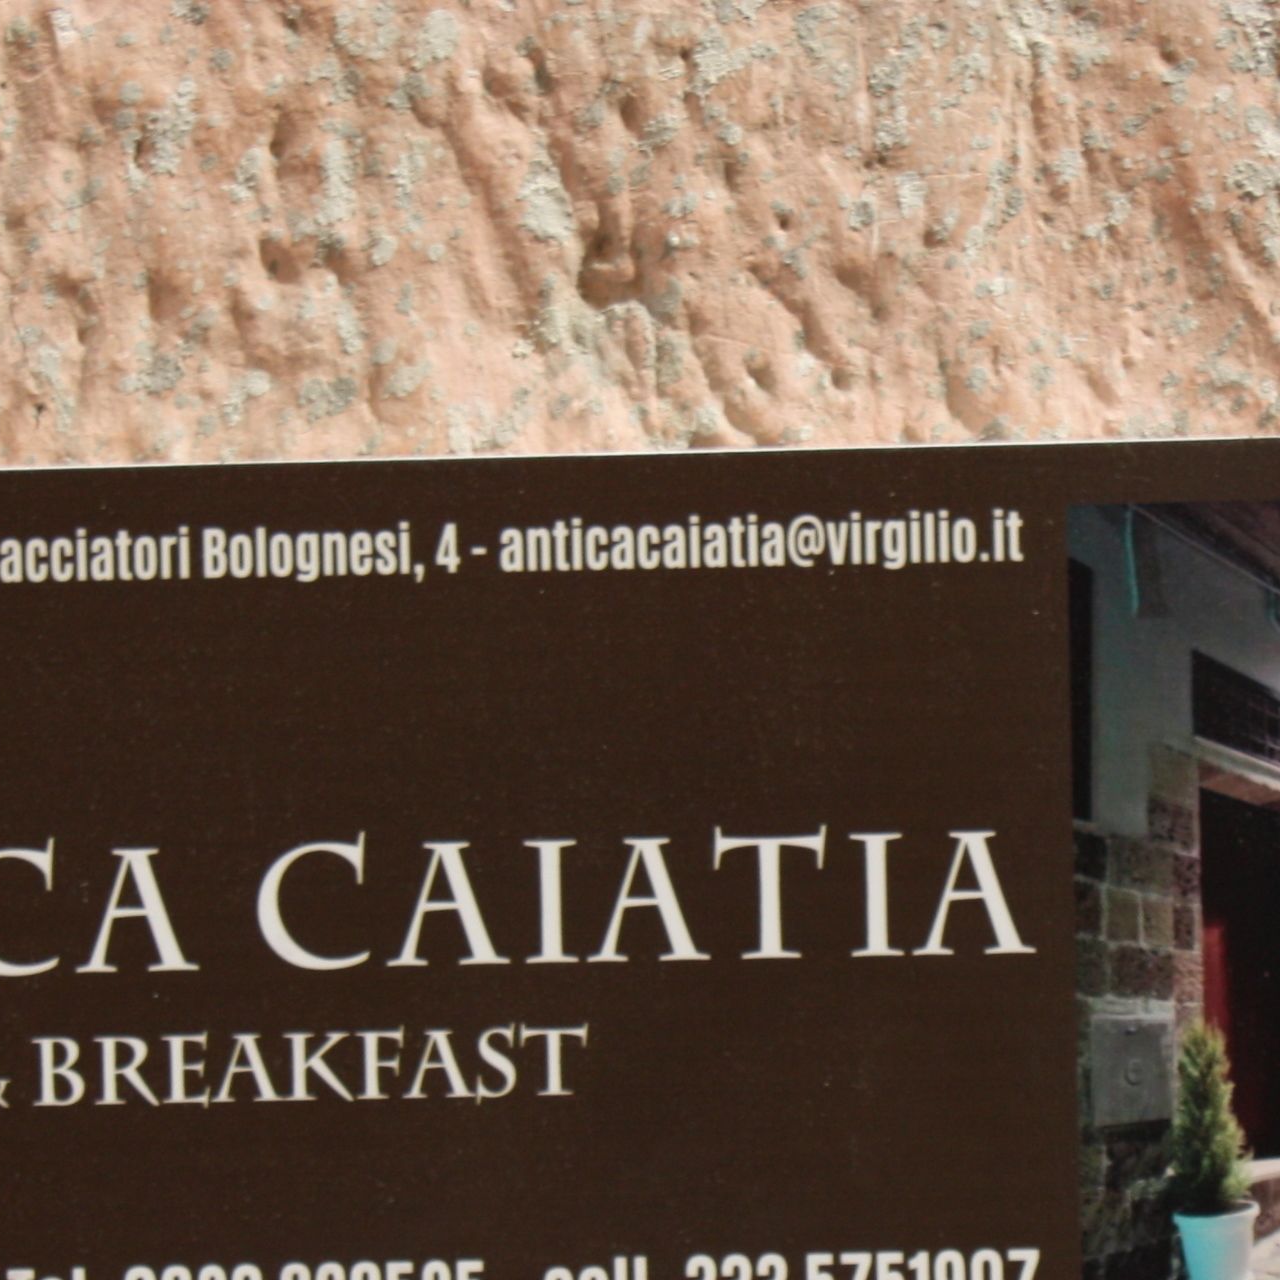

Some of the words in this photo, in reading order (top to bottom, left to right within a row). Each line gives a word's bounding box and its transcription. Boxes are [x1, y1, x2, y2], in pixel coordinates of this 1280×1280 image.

[202, 520, 426, 583] Bolognesi,
[435, 522, 461, 575] 4
[499, 508, 1025, 574] anticacaiatia@virgilio.it
[257, 823, 1037, 972] CAIATIA
[32, 1022, 589, 1108] BREAKFAST
